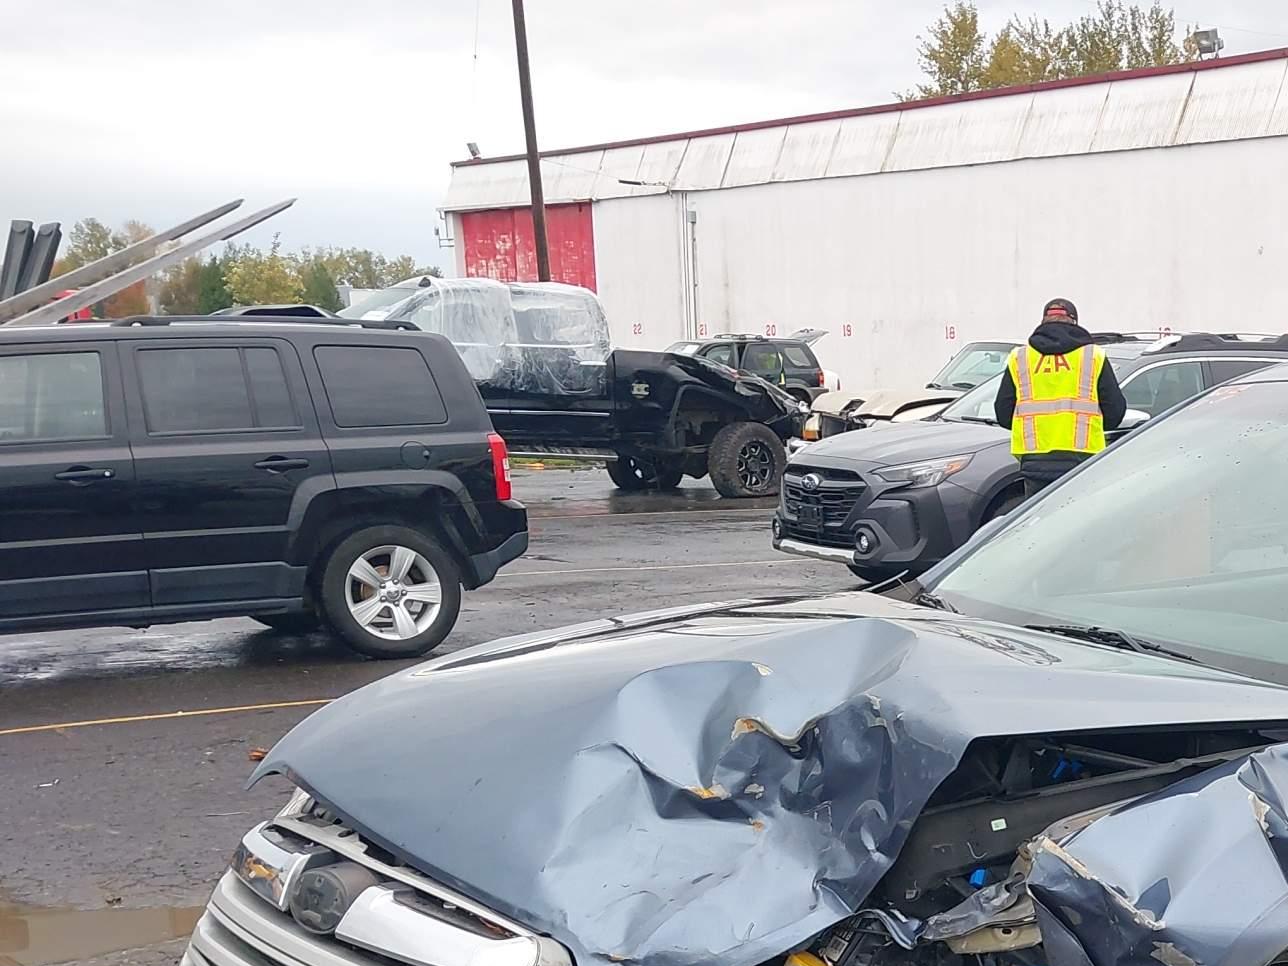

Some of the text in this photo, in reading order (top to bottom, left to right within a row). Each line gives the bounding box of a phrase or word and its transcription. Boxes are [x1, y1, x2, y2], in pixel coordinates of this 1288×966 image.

[699, 324, 708, 336] 21
[766, 324, 776, 336] 20
[843, 324, 852, 337] 19
[945, 326, 955, 339] 18
